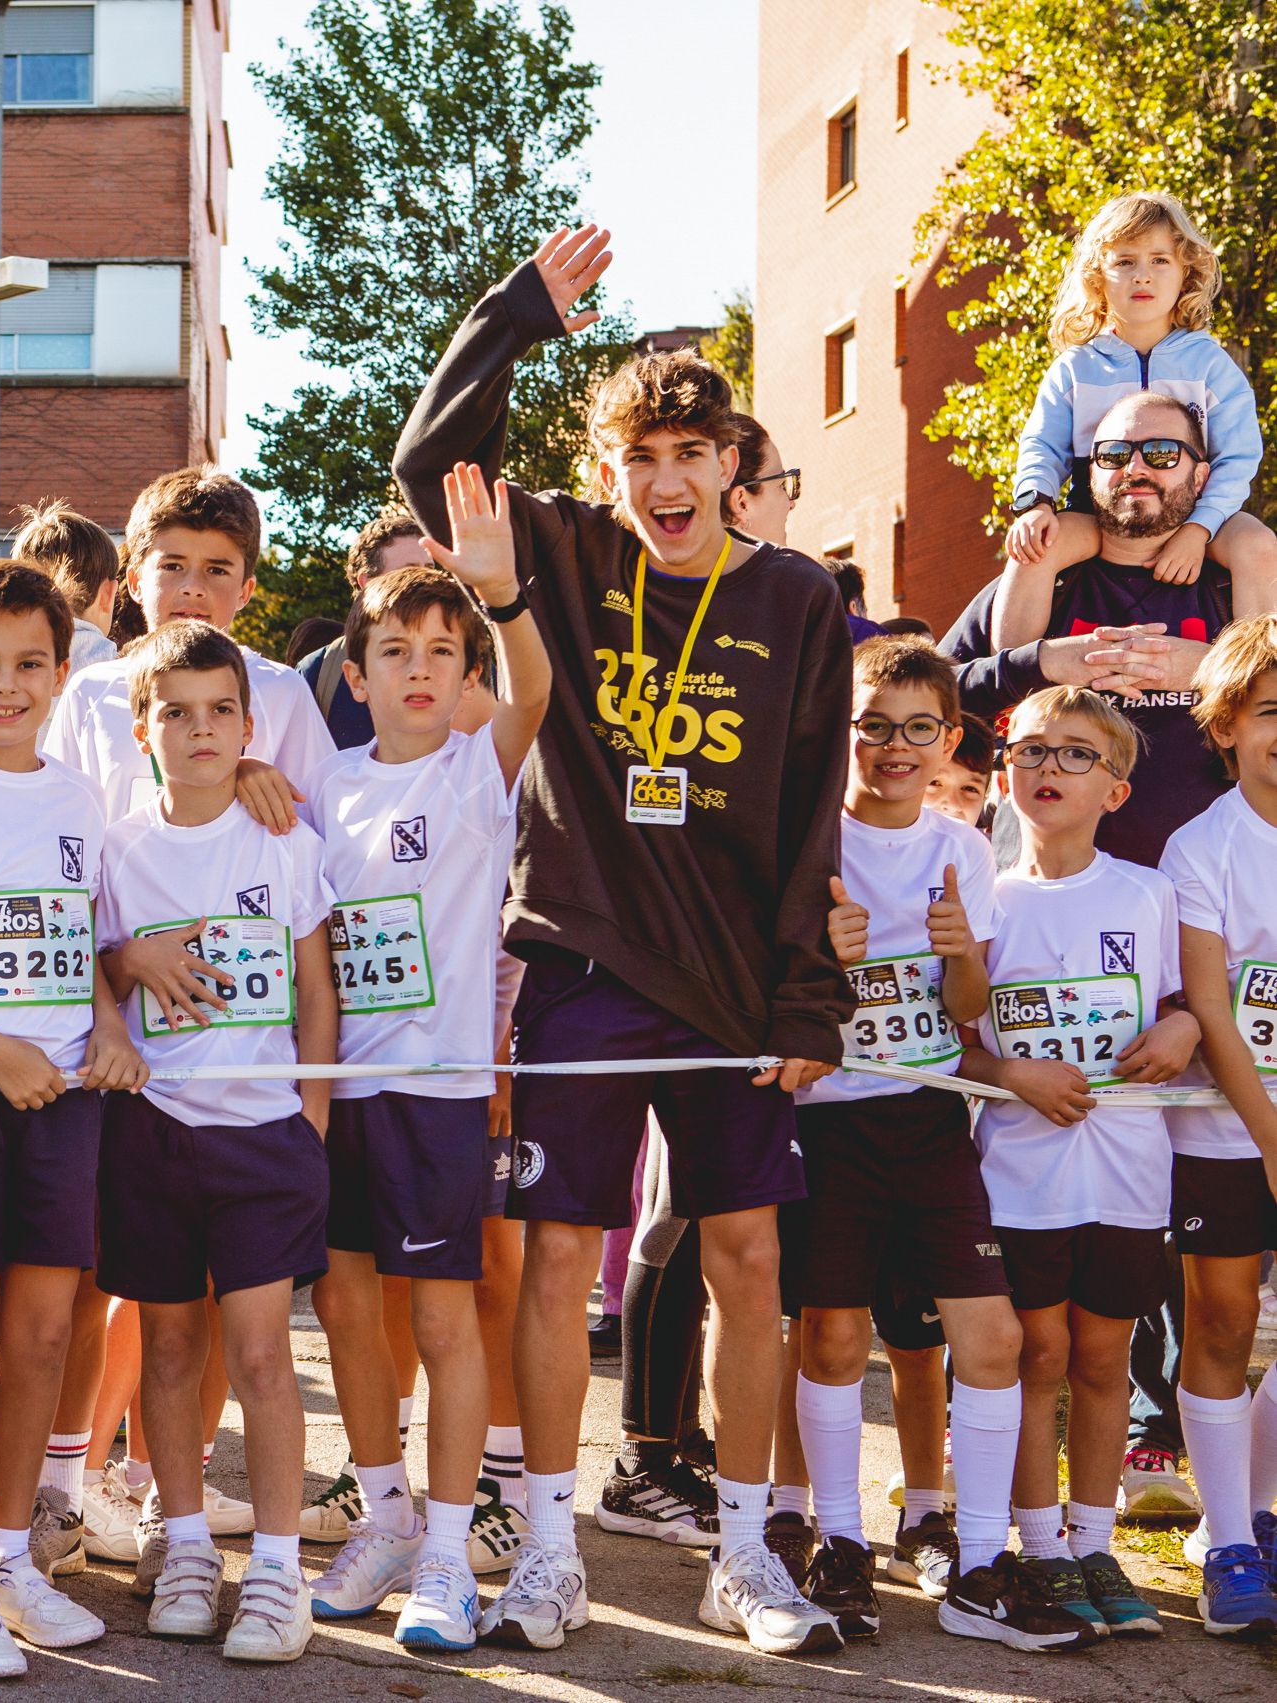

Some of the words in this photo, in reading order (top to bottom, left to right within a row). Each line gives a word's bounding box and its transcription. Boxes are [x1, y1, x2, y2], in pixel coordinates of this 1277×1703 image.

[665, 671, 707, 684] Cutat
[707, 671, 725, 685] de
[663, 680, 696, 694] Snt
[697, 684, 737, 699] Cugat
[633, 787, 681, 804] CROS
[855, 980, 897, 1001] ROS
[1249, 984, 1277, 1003] CR
[999, 1003, 1049, 1024] CROS
[855, 1010, 947, 1046] 3305
[1012, 1034, 1113, 1062] 3312
